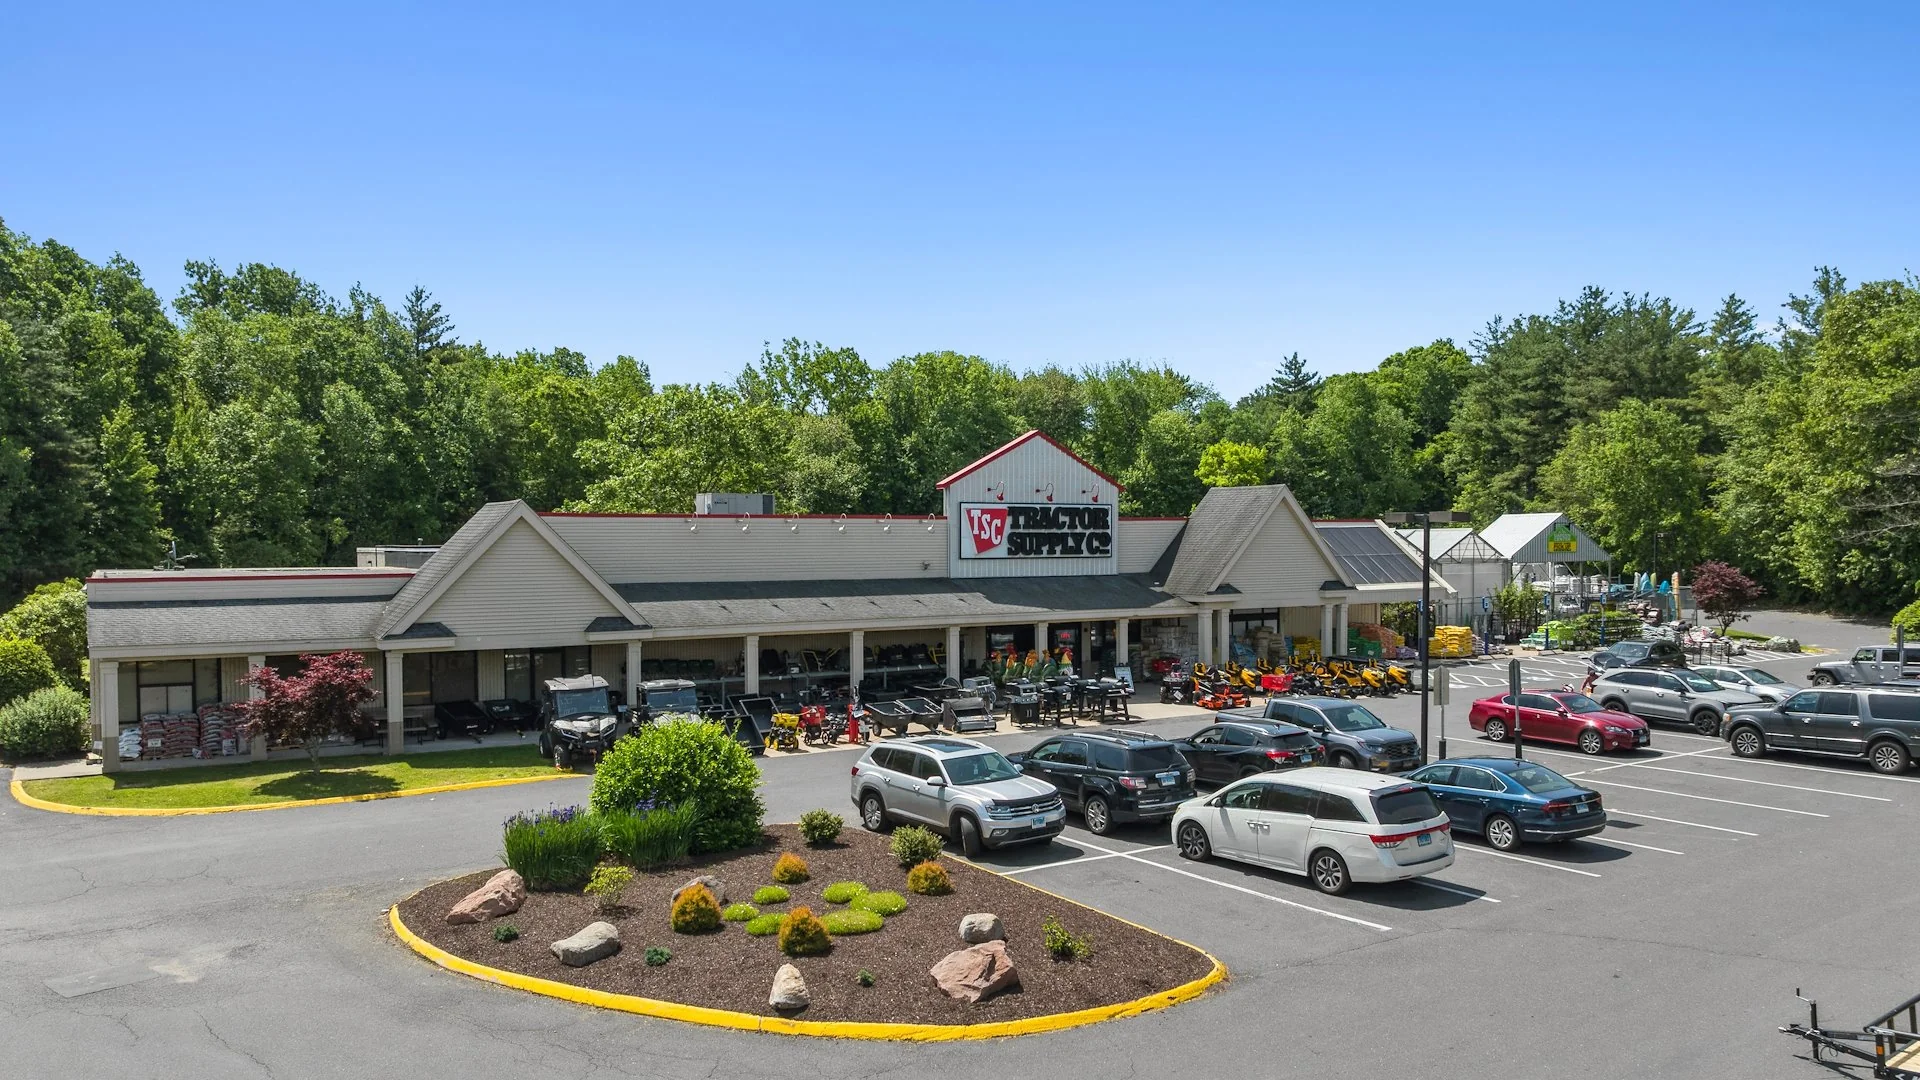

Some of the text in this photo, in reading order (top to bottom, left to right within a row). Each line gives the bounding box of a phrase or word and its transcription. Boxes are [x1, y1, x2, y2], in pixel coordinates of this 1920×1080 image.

[971, 509, 1001, 545] TSC
[1007, 506, 1110, 530] TRACTOR
[1007, 532, 1086, 556] SUPPLY
